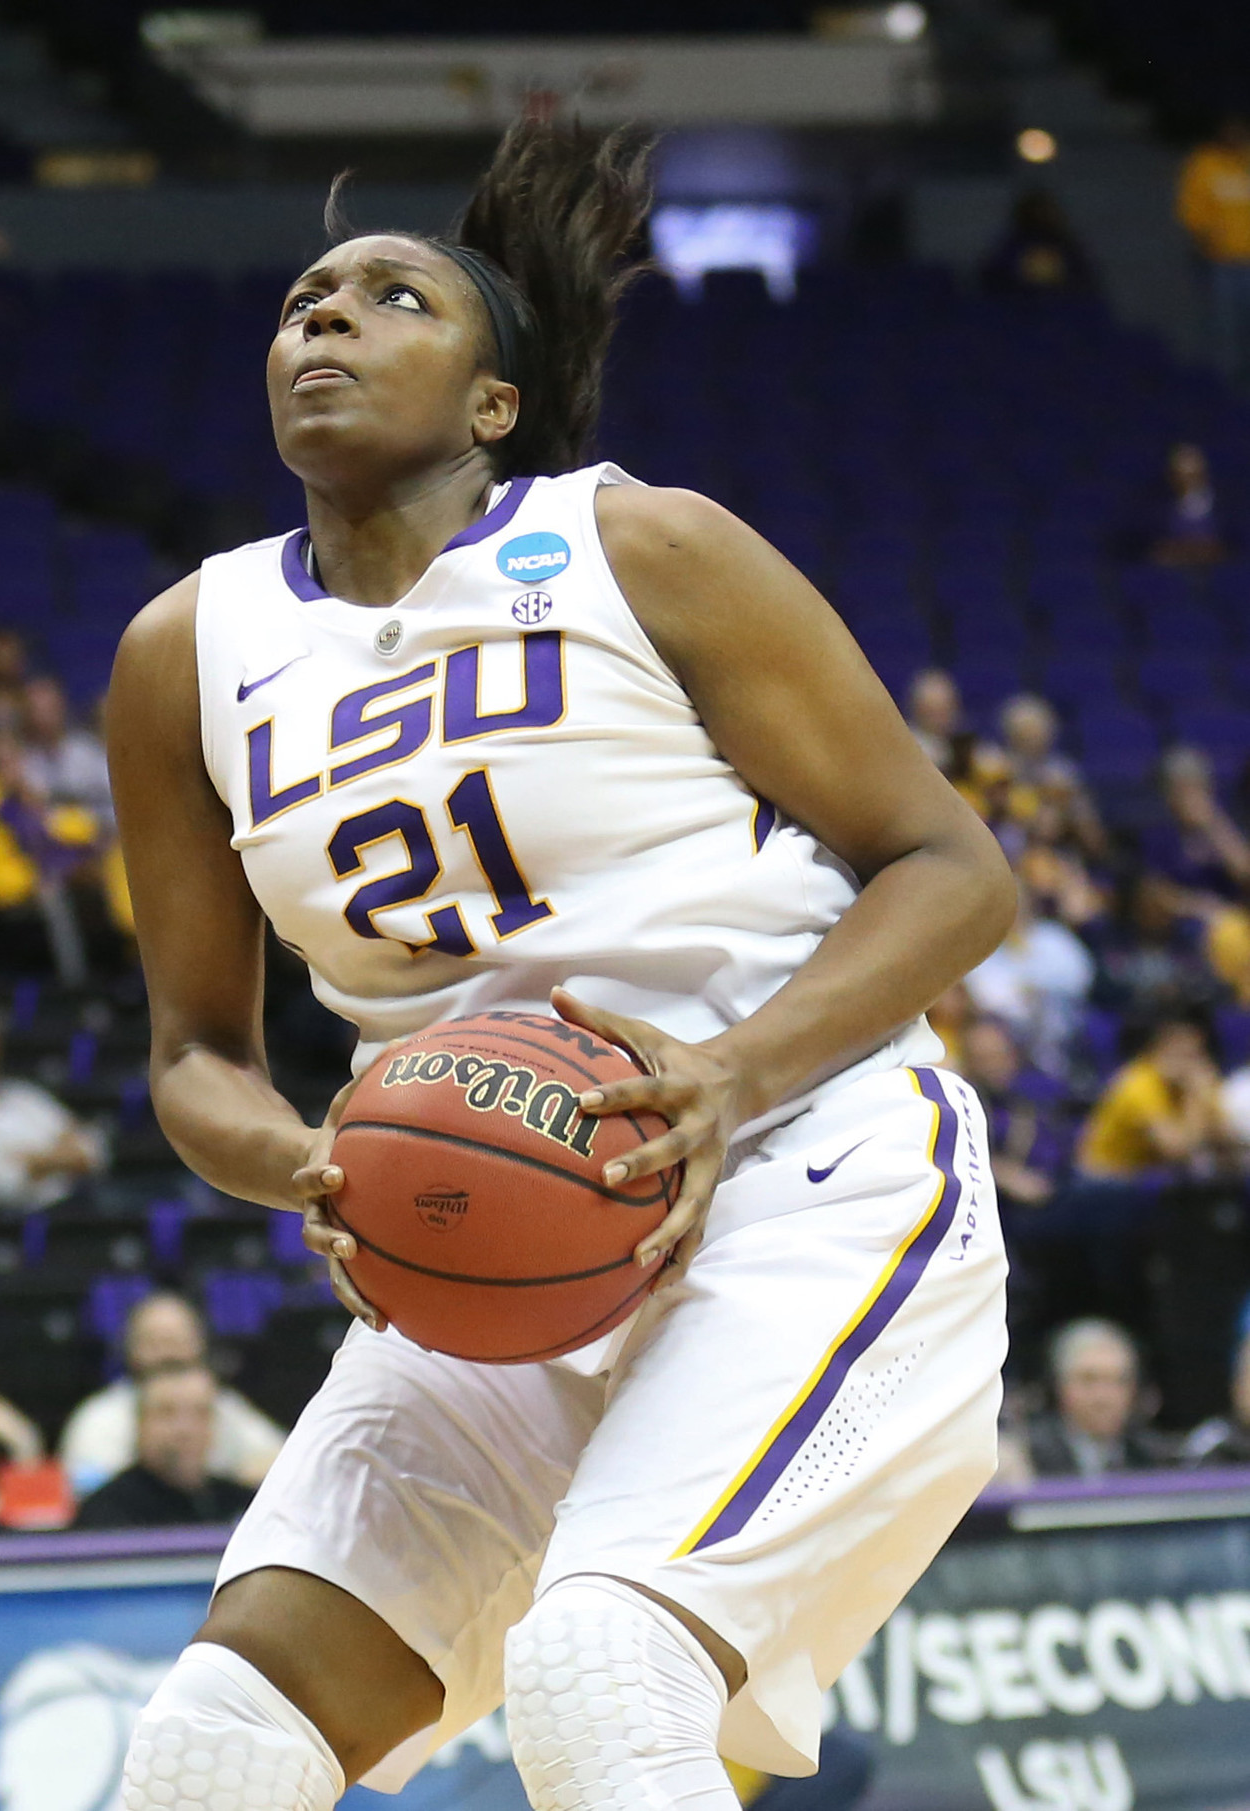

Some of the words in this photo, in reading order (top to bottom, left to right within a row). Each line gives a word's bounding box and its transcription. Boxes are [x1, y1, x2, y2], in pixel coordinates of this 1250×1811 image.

[507, 551, 567, 571] NCAA
[513, 592, 552, 624] SEC
[244, 629, 568, 834] LSU
[324, 764, 558, 958] 21
[381, 1051, 600, 1160] Wilson
[414, 1197, 468, 1214] Wilson
[950, 1192, 981, 1261] LADY
[821, 1593, 1250, 1744] T/SECON
[976, 1736, 1134, 1811] LSU
